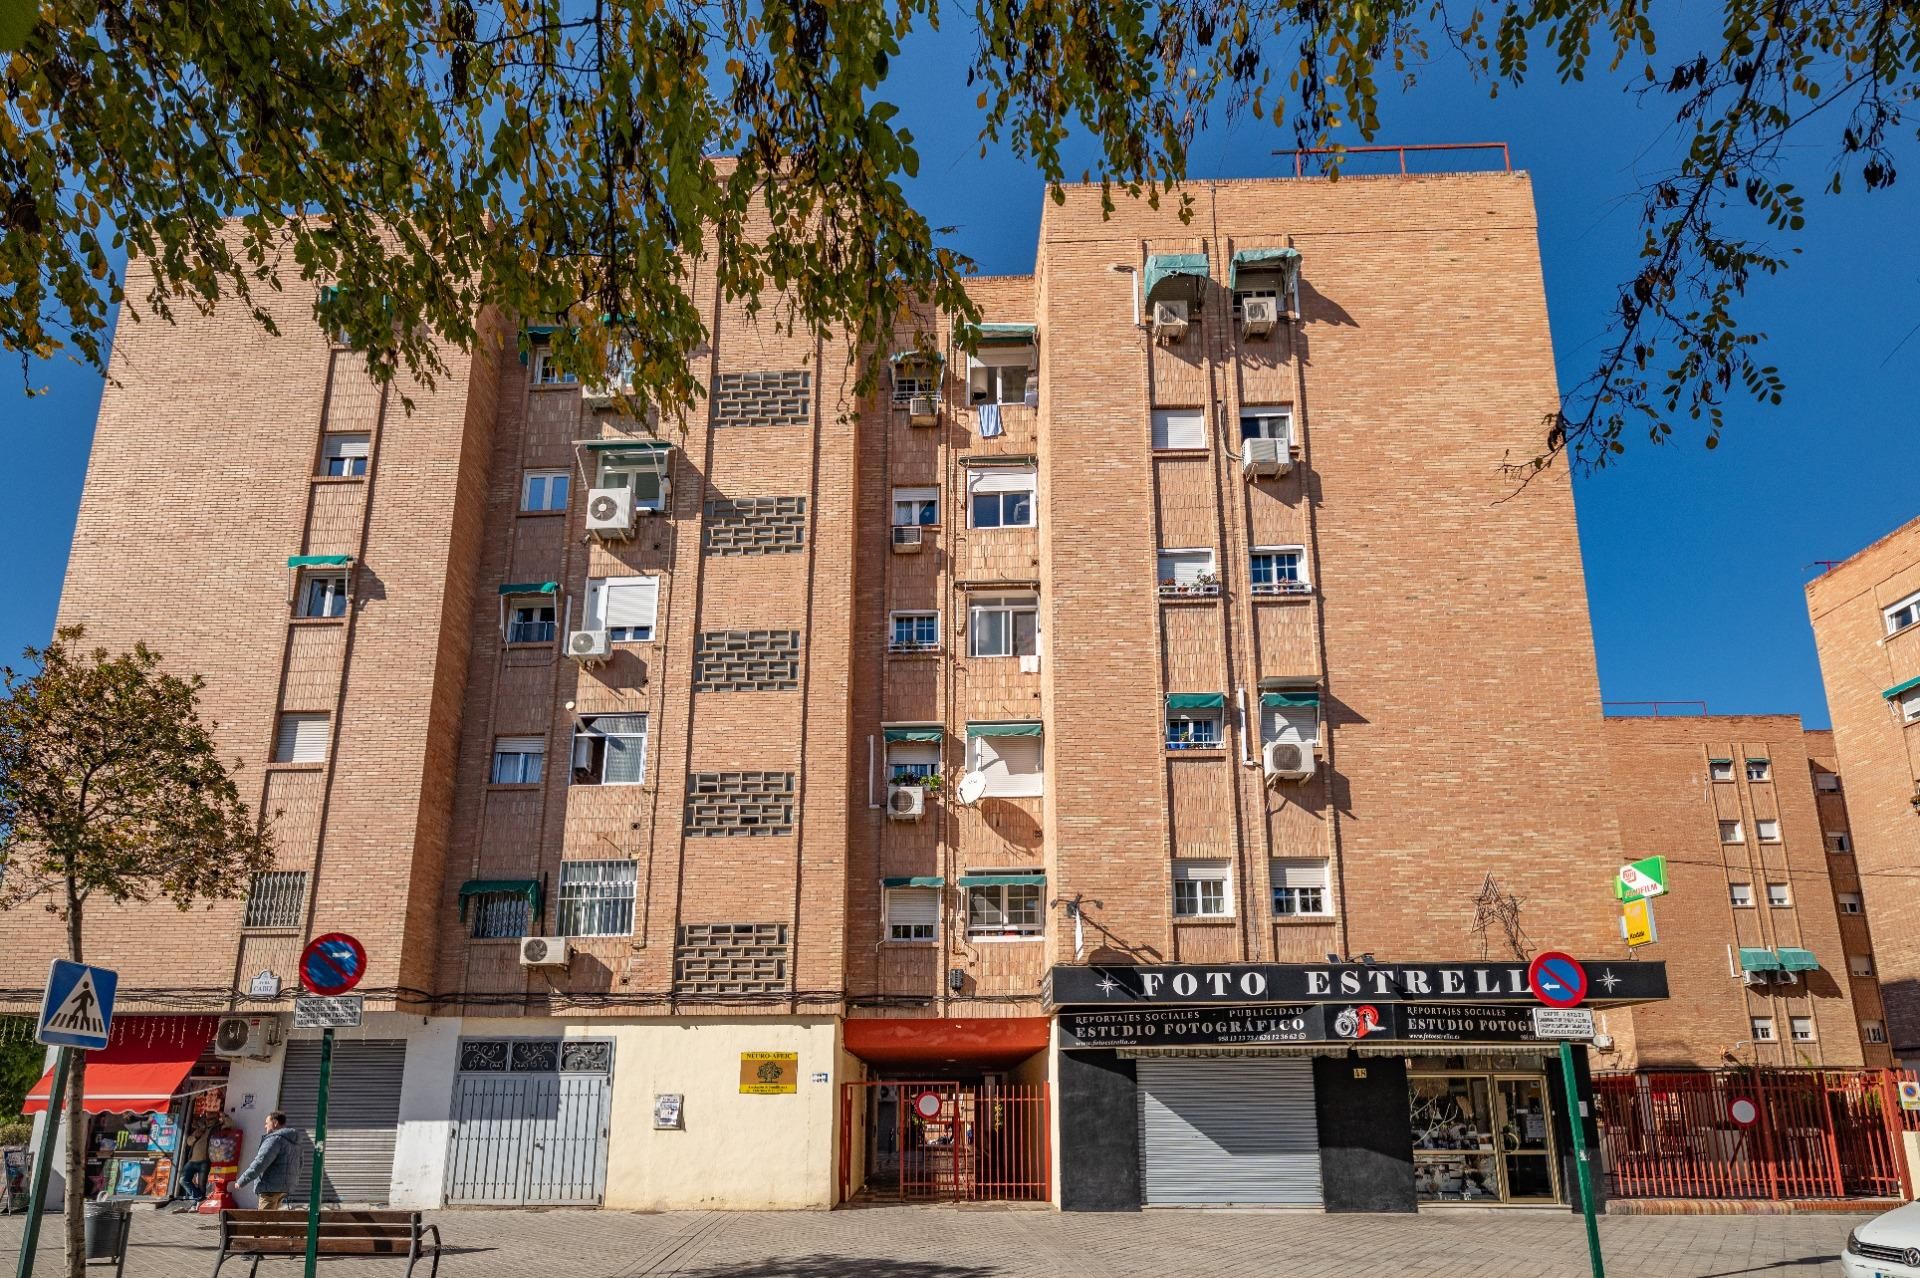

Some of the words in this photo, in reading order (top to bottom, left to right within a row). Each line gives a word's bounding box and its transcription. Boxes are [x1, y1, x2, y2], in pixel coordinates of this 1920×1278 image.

[1140, 972, 1267, 996] FOTO
[1304, 969, 1532, 995] ESTRELL
[1075, 1013, 1141, 1025] REPORTAJES
[1144, 1011, 1200, 1021] SOCIALES
[1229, 1007, 1304, 1018] PUBLICIDAD
[1407, 1006, 1461, 1016] REPORTAJES
[1464, 1008, 1506, 1017] SOCIALES
[1075, 1024, 1156, 1038] ESTUDIO
[1164, 1017, 1305, 1035] FOTOGRÁFICO
[1407, 1018, 1474, 1031] ESTUDIO
